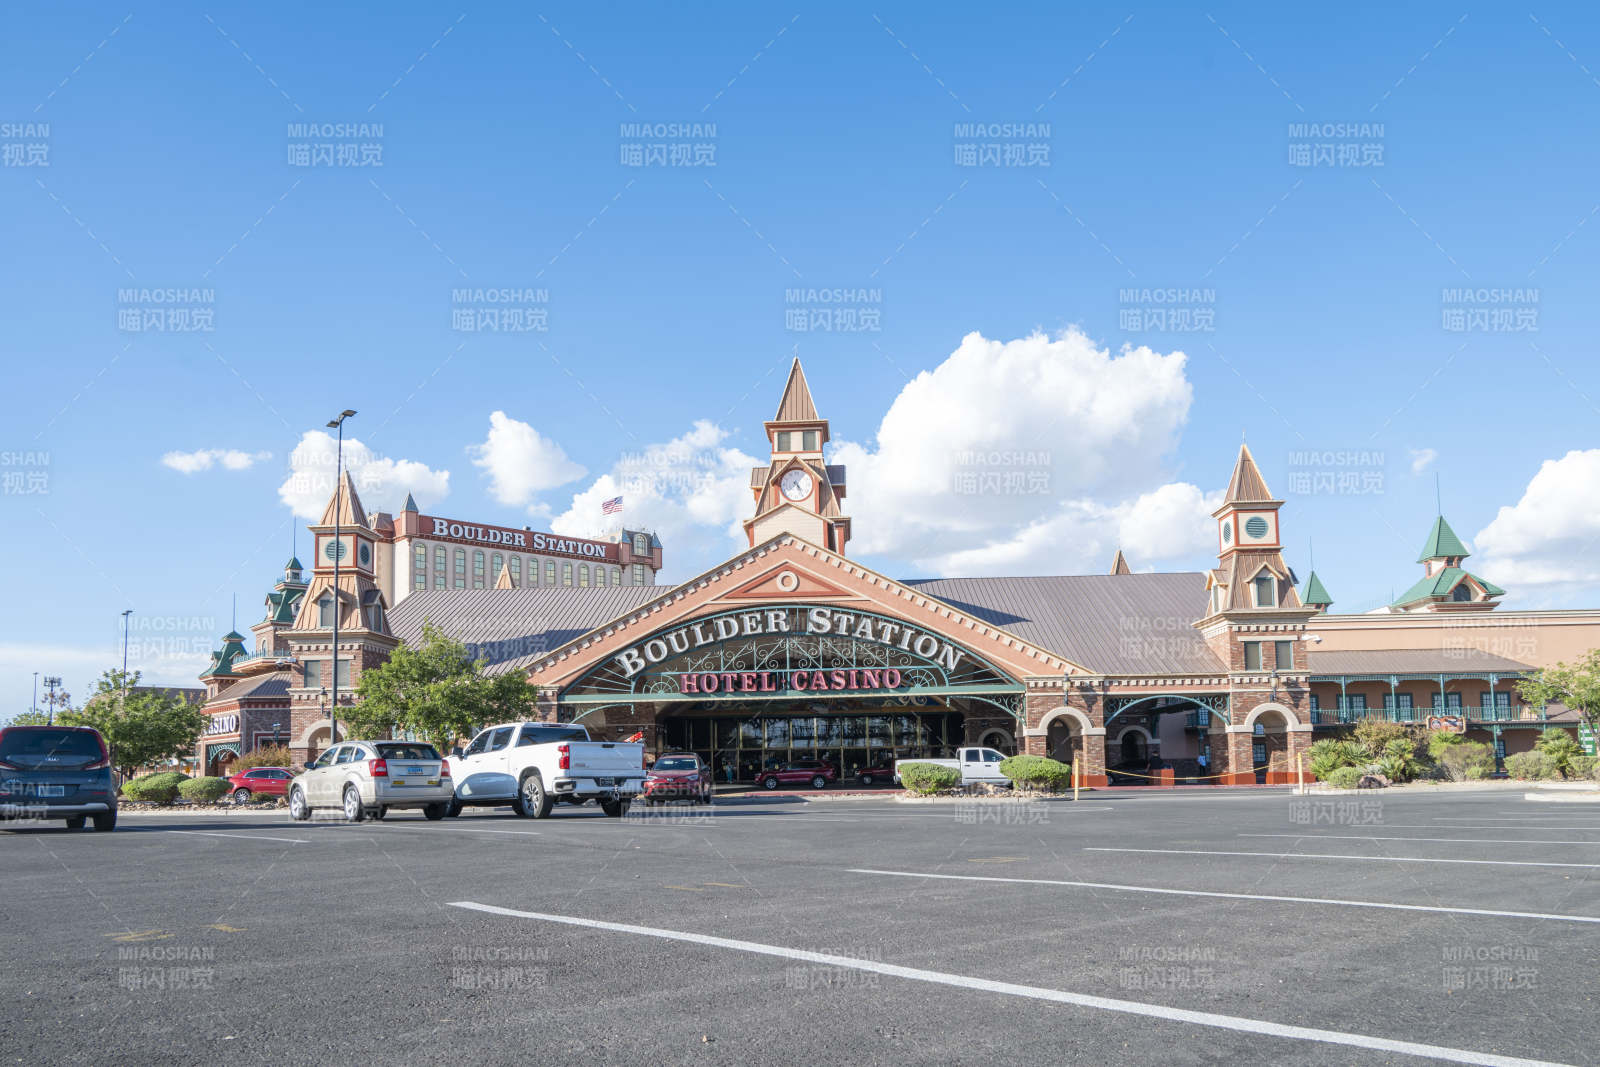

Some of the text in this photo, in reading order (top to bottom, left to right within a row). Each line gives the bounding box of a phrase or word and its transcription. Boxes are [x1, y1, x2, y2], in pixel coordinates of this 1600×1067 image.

[432, 518, 607, 558] BOULDER STATION
[615, 606, 965, 678] BOULDER STATION
[679, 668, 902, 694] HOTEL CASINO
